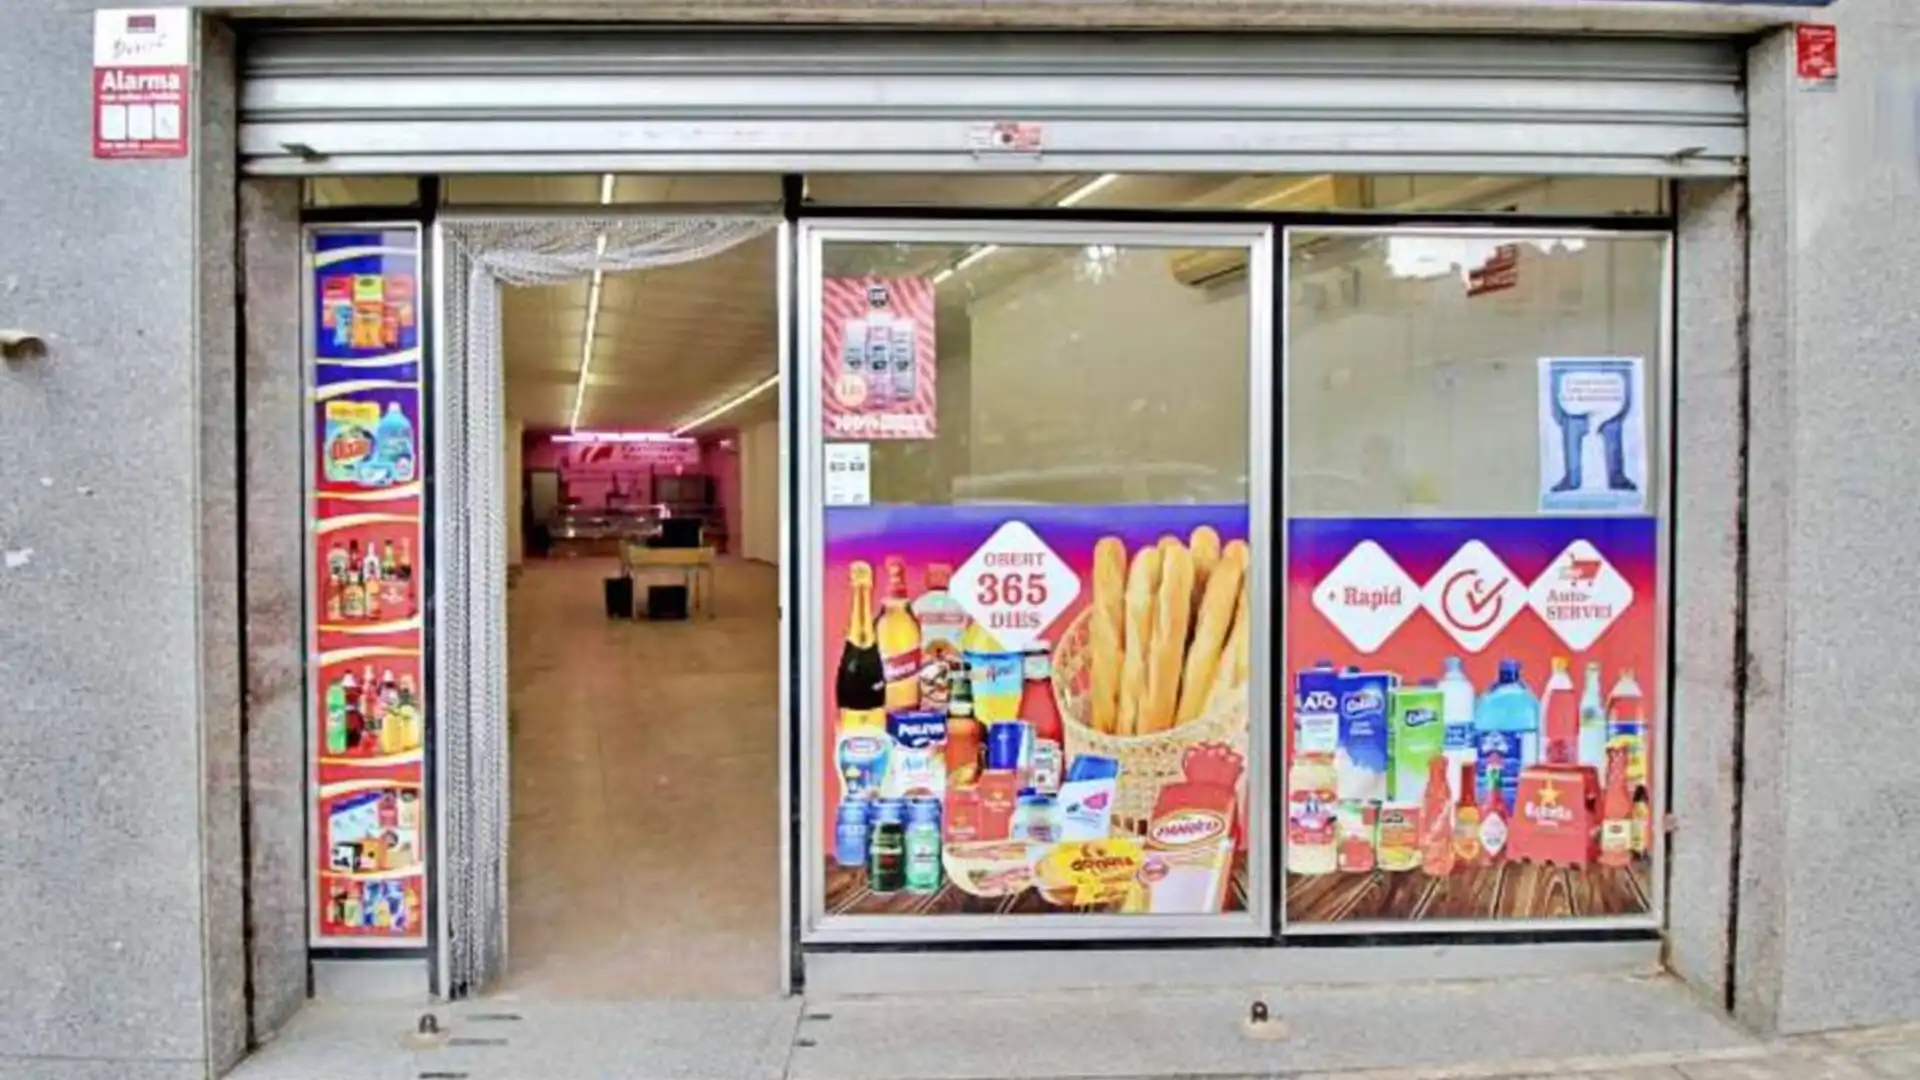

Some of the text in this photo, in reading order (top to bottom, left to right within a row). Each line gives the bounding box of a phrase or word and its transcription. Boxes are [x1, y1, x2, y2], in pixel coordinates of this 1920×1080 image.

[102, 70, 181, 90] Alarma
[984, 551, 1045, 567] OBERT
[977, 572, 1048, 606] 365
[1343, 586, 1402, 611] Rapid
[989, 611, 1042, 629] DIES
